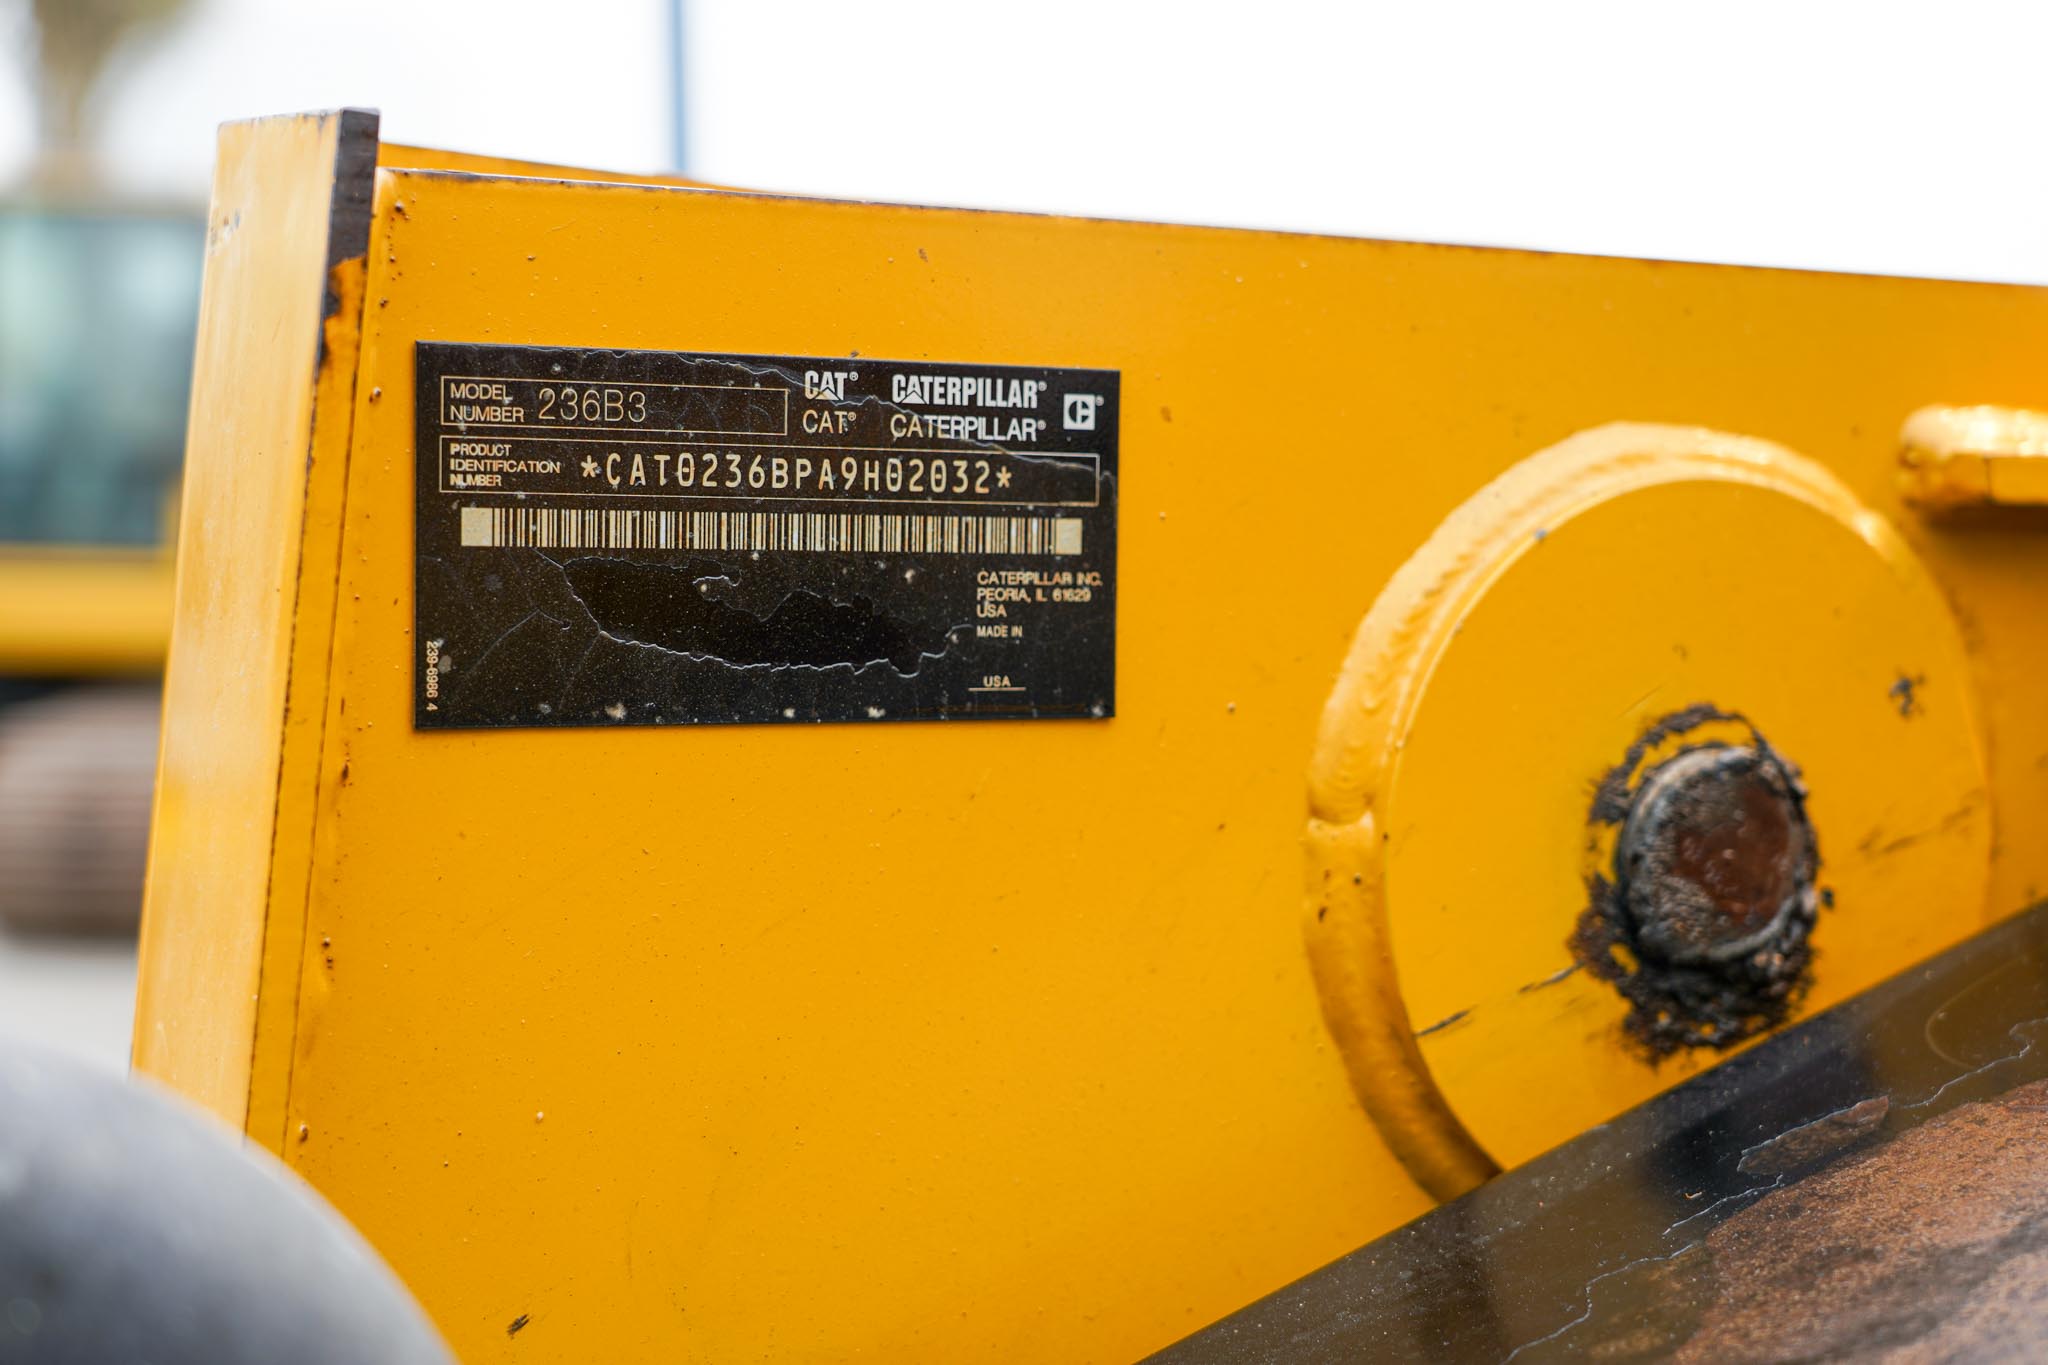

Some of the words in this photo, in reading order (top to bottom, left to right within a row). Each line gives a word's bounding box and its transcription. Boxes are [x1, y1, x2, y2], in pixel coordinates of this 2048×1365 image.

[450, 382, 513, 401] MODEL
[538, 387, 647, 424] 236B3
[450, 405, 524, 423] NUMBER
[450, 443, 512, 457] PRODUCT
[450, 458, 561, 474] IDENTIFICATION
[450, 473, 502, 487] NUMBER
[976, 571, 1072, 586] CATERPILLAR
[1076, 571, 1104, 587] INC.
[976, 587, 1032, 603] PEORIA,
[1035, 588, 1048, 602] IL
[1052, 588, 1092, 602] 61629
[976, 603, 1007, 618] USA
[976, 625, 1009, 638] MADE
[1011, 625, 1023, 637] IN
[426, 641, 439, 698] 239-6986
[983, 675, 1012, 688] USA
